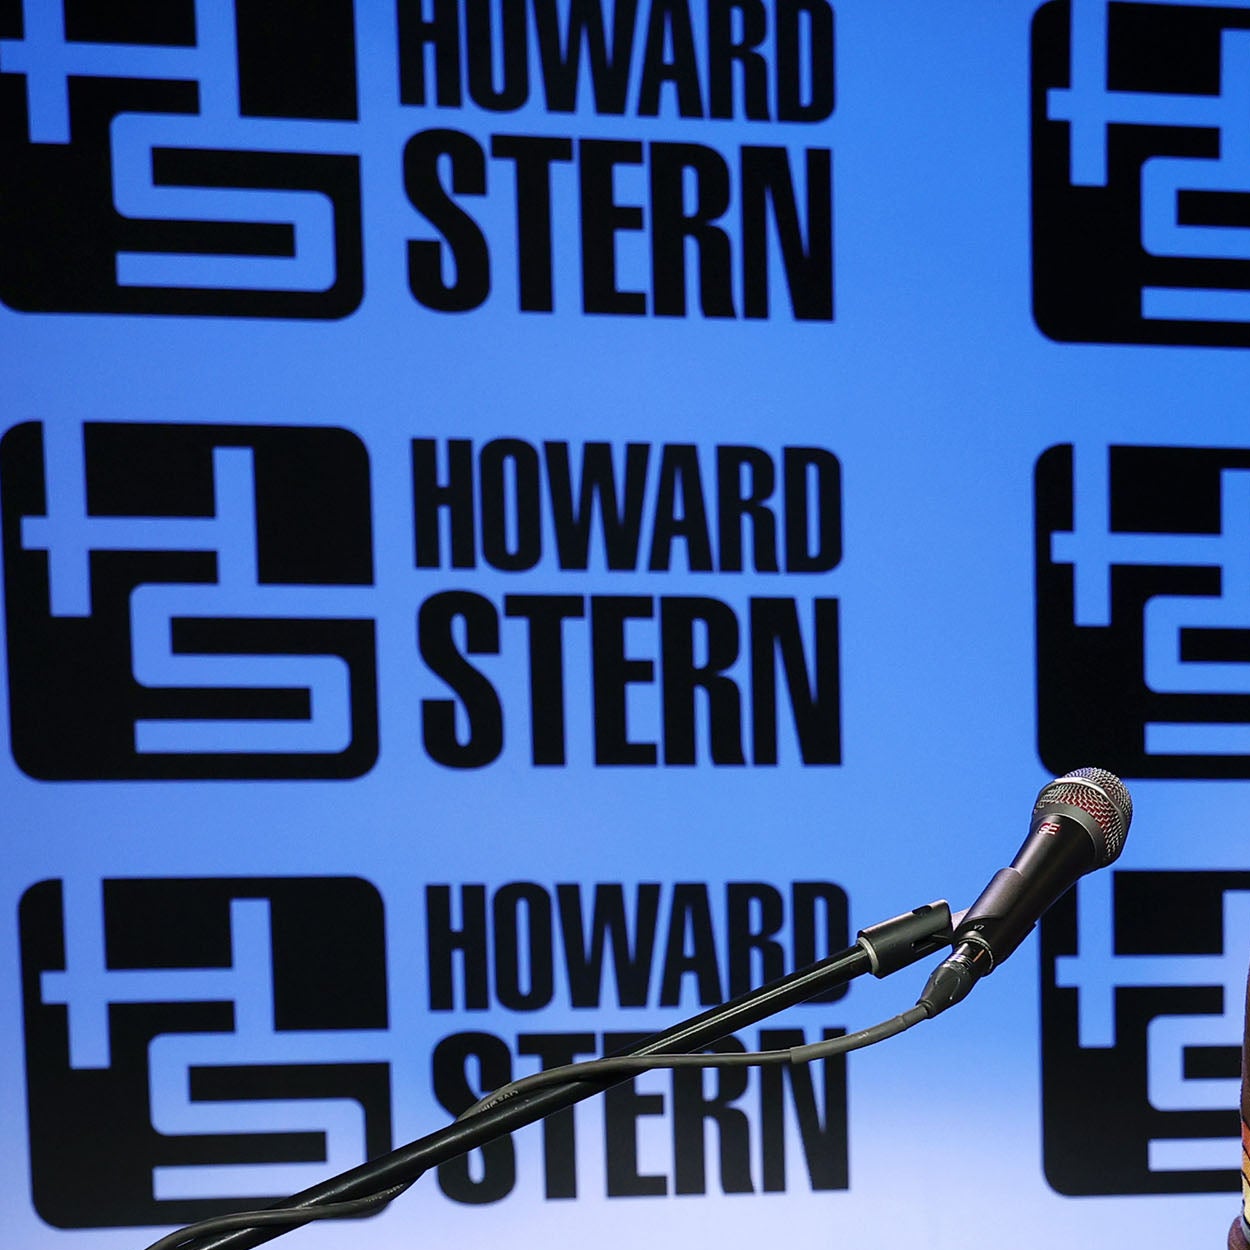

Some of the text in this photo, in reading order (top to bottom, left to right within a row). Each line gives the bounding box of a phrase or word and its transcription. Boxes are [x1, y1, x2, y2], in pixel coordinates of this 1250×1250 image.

[398, 0, 837, 123] HOWARD
[401, 127, 836, 323] STERN
[410, 437, 843, 574] HOWARD
[417, 589, 843, 770] STERN
[423, 880, 850, 1012] HOWARD
[431, 1026, 850, 1206] STERN
